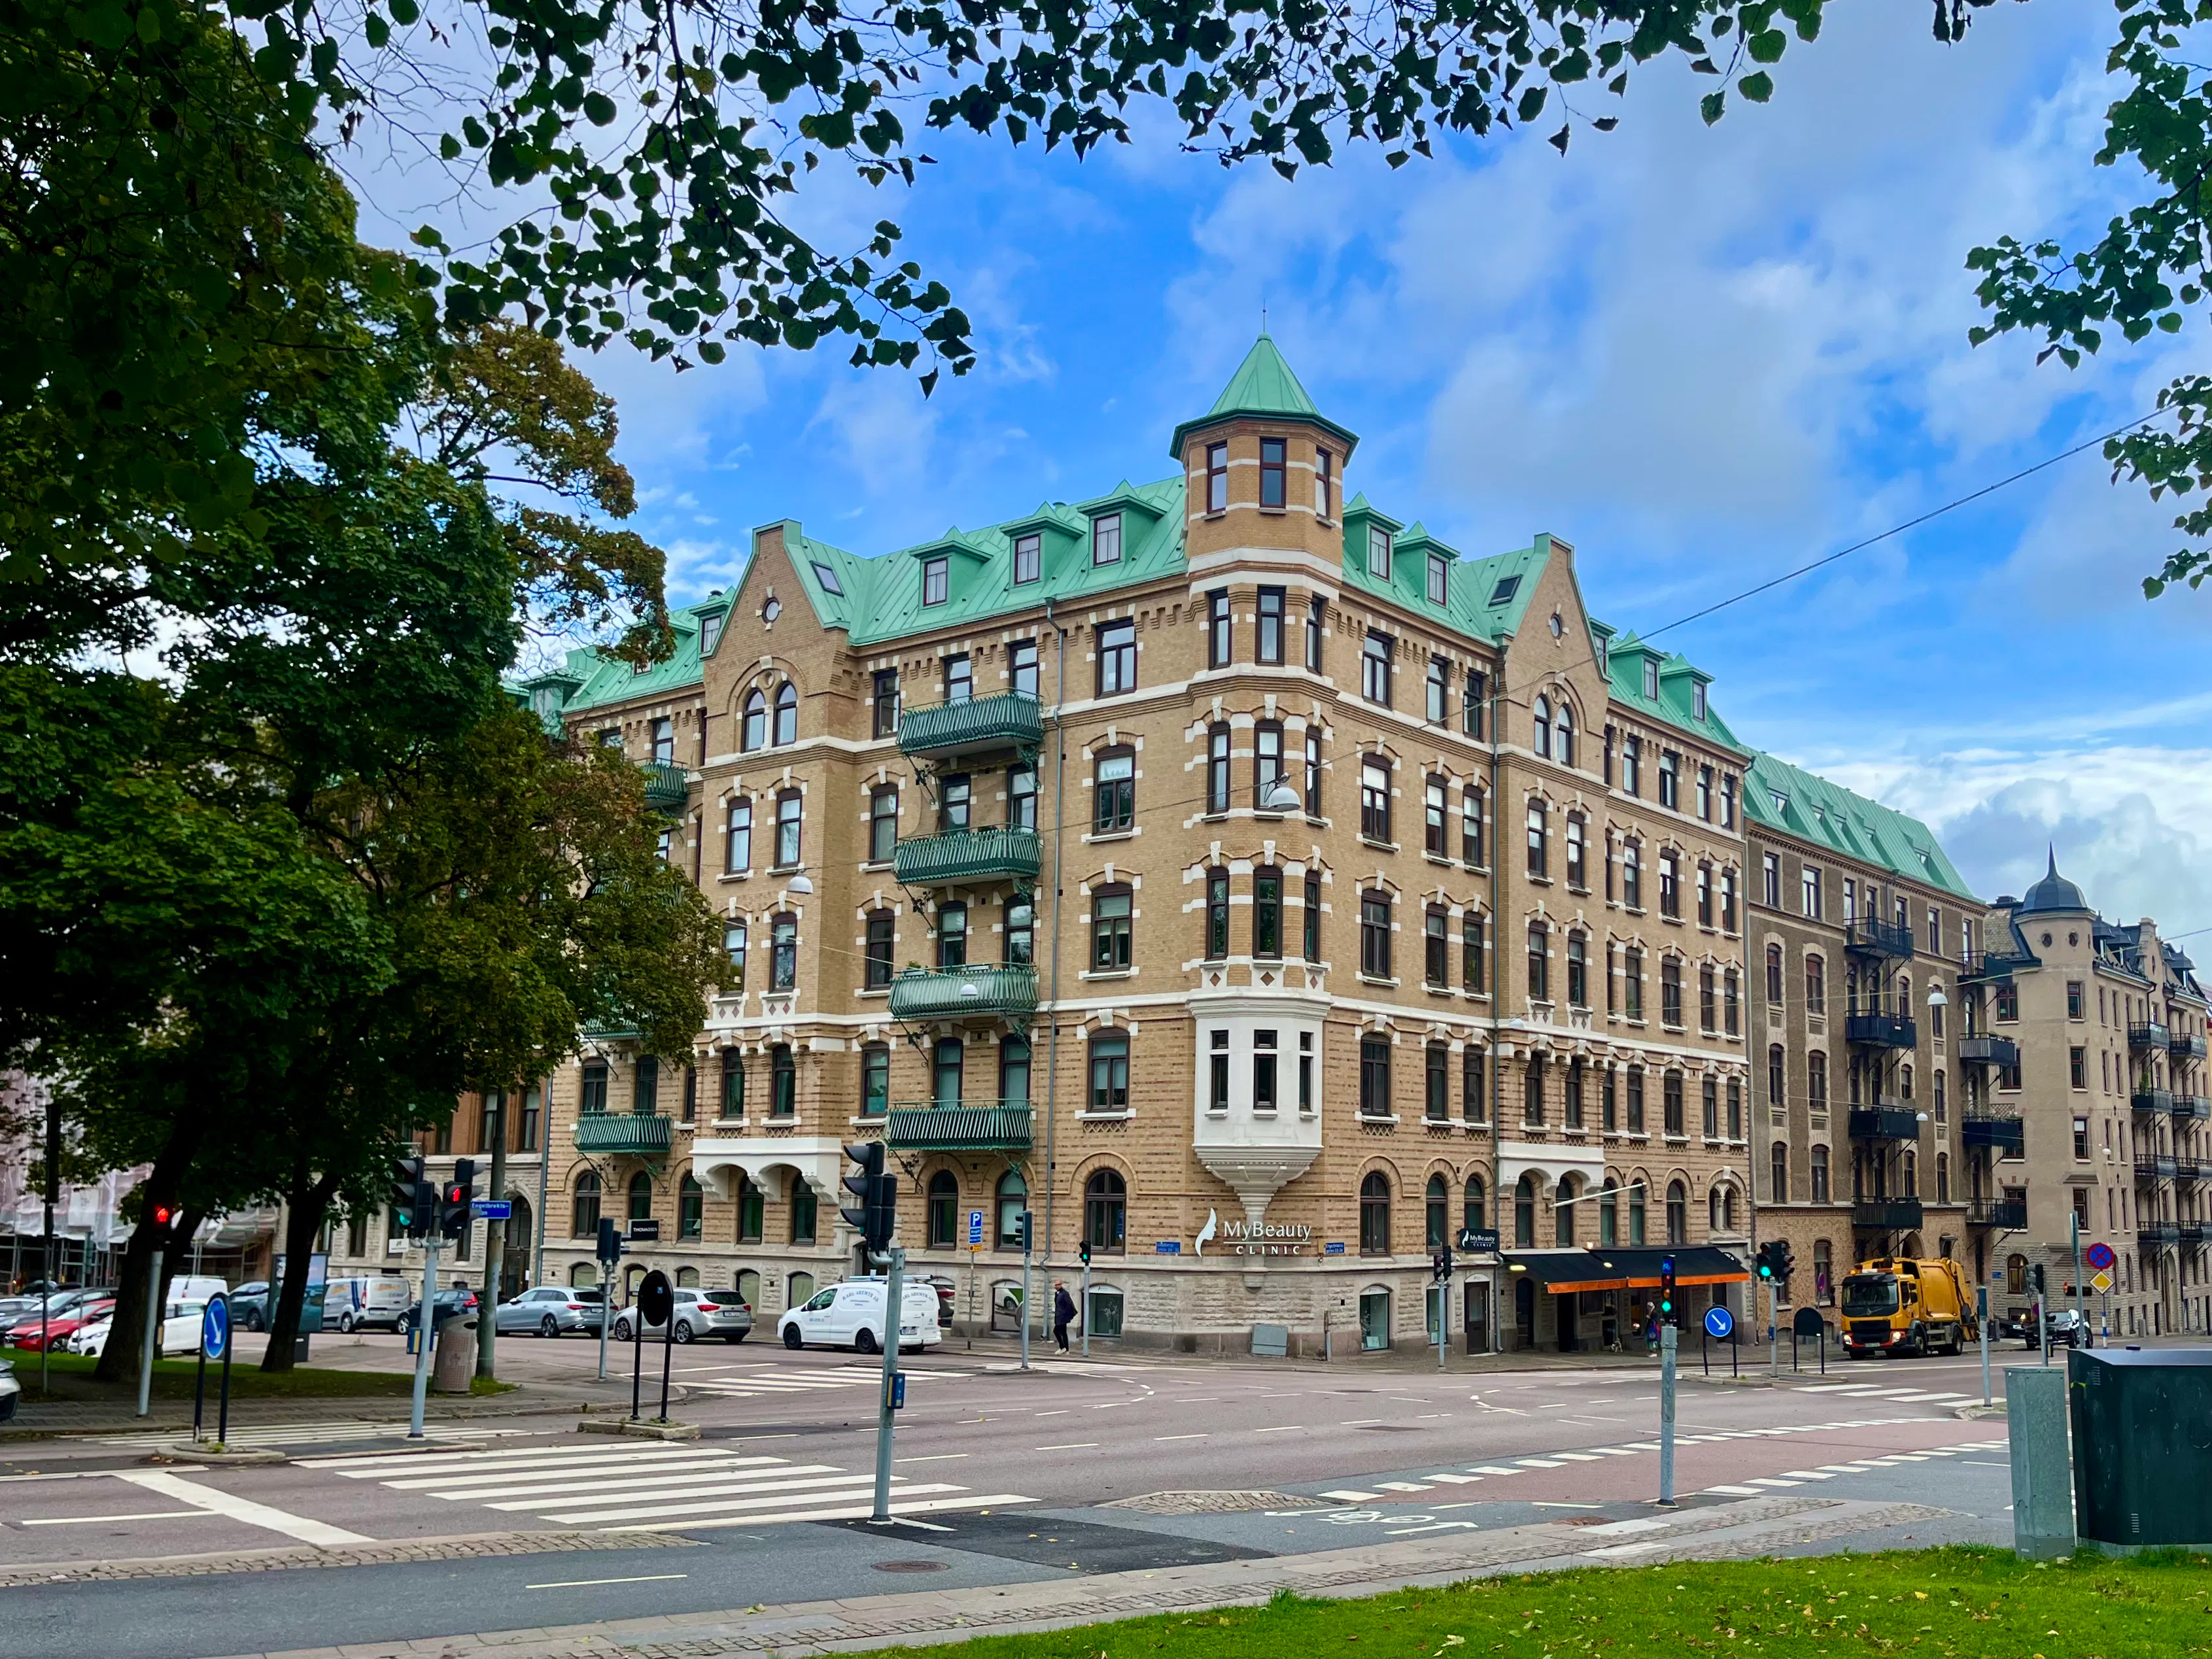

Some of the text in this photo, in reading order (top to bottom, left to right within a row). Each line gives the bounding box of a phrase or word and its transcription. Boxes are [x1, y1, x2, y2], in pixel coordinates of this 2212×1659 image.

[973, 1213, 980, 1226] P
[1224, 1221, 1312, 1241] MyBeauty
[1470, 1235, 1495, 1244] MyBeauty
[1236, 1246, 1300, 1255] CLINIC
